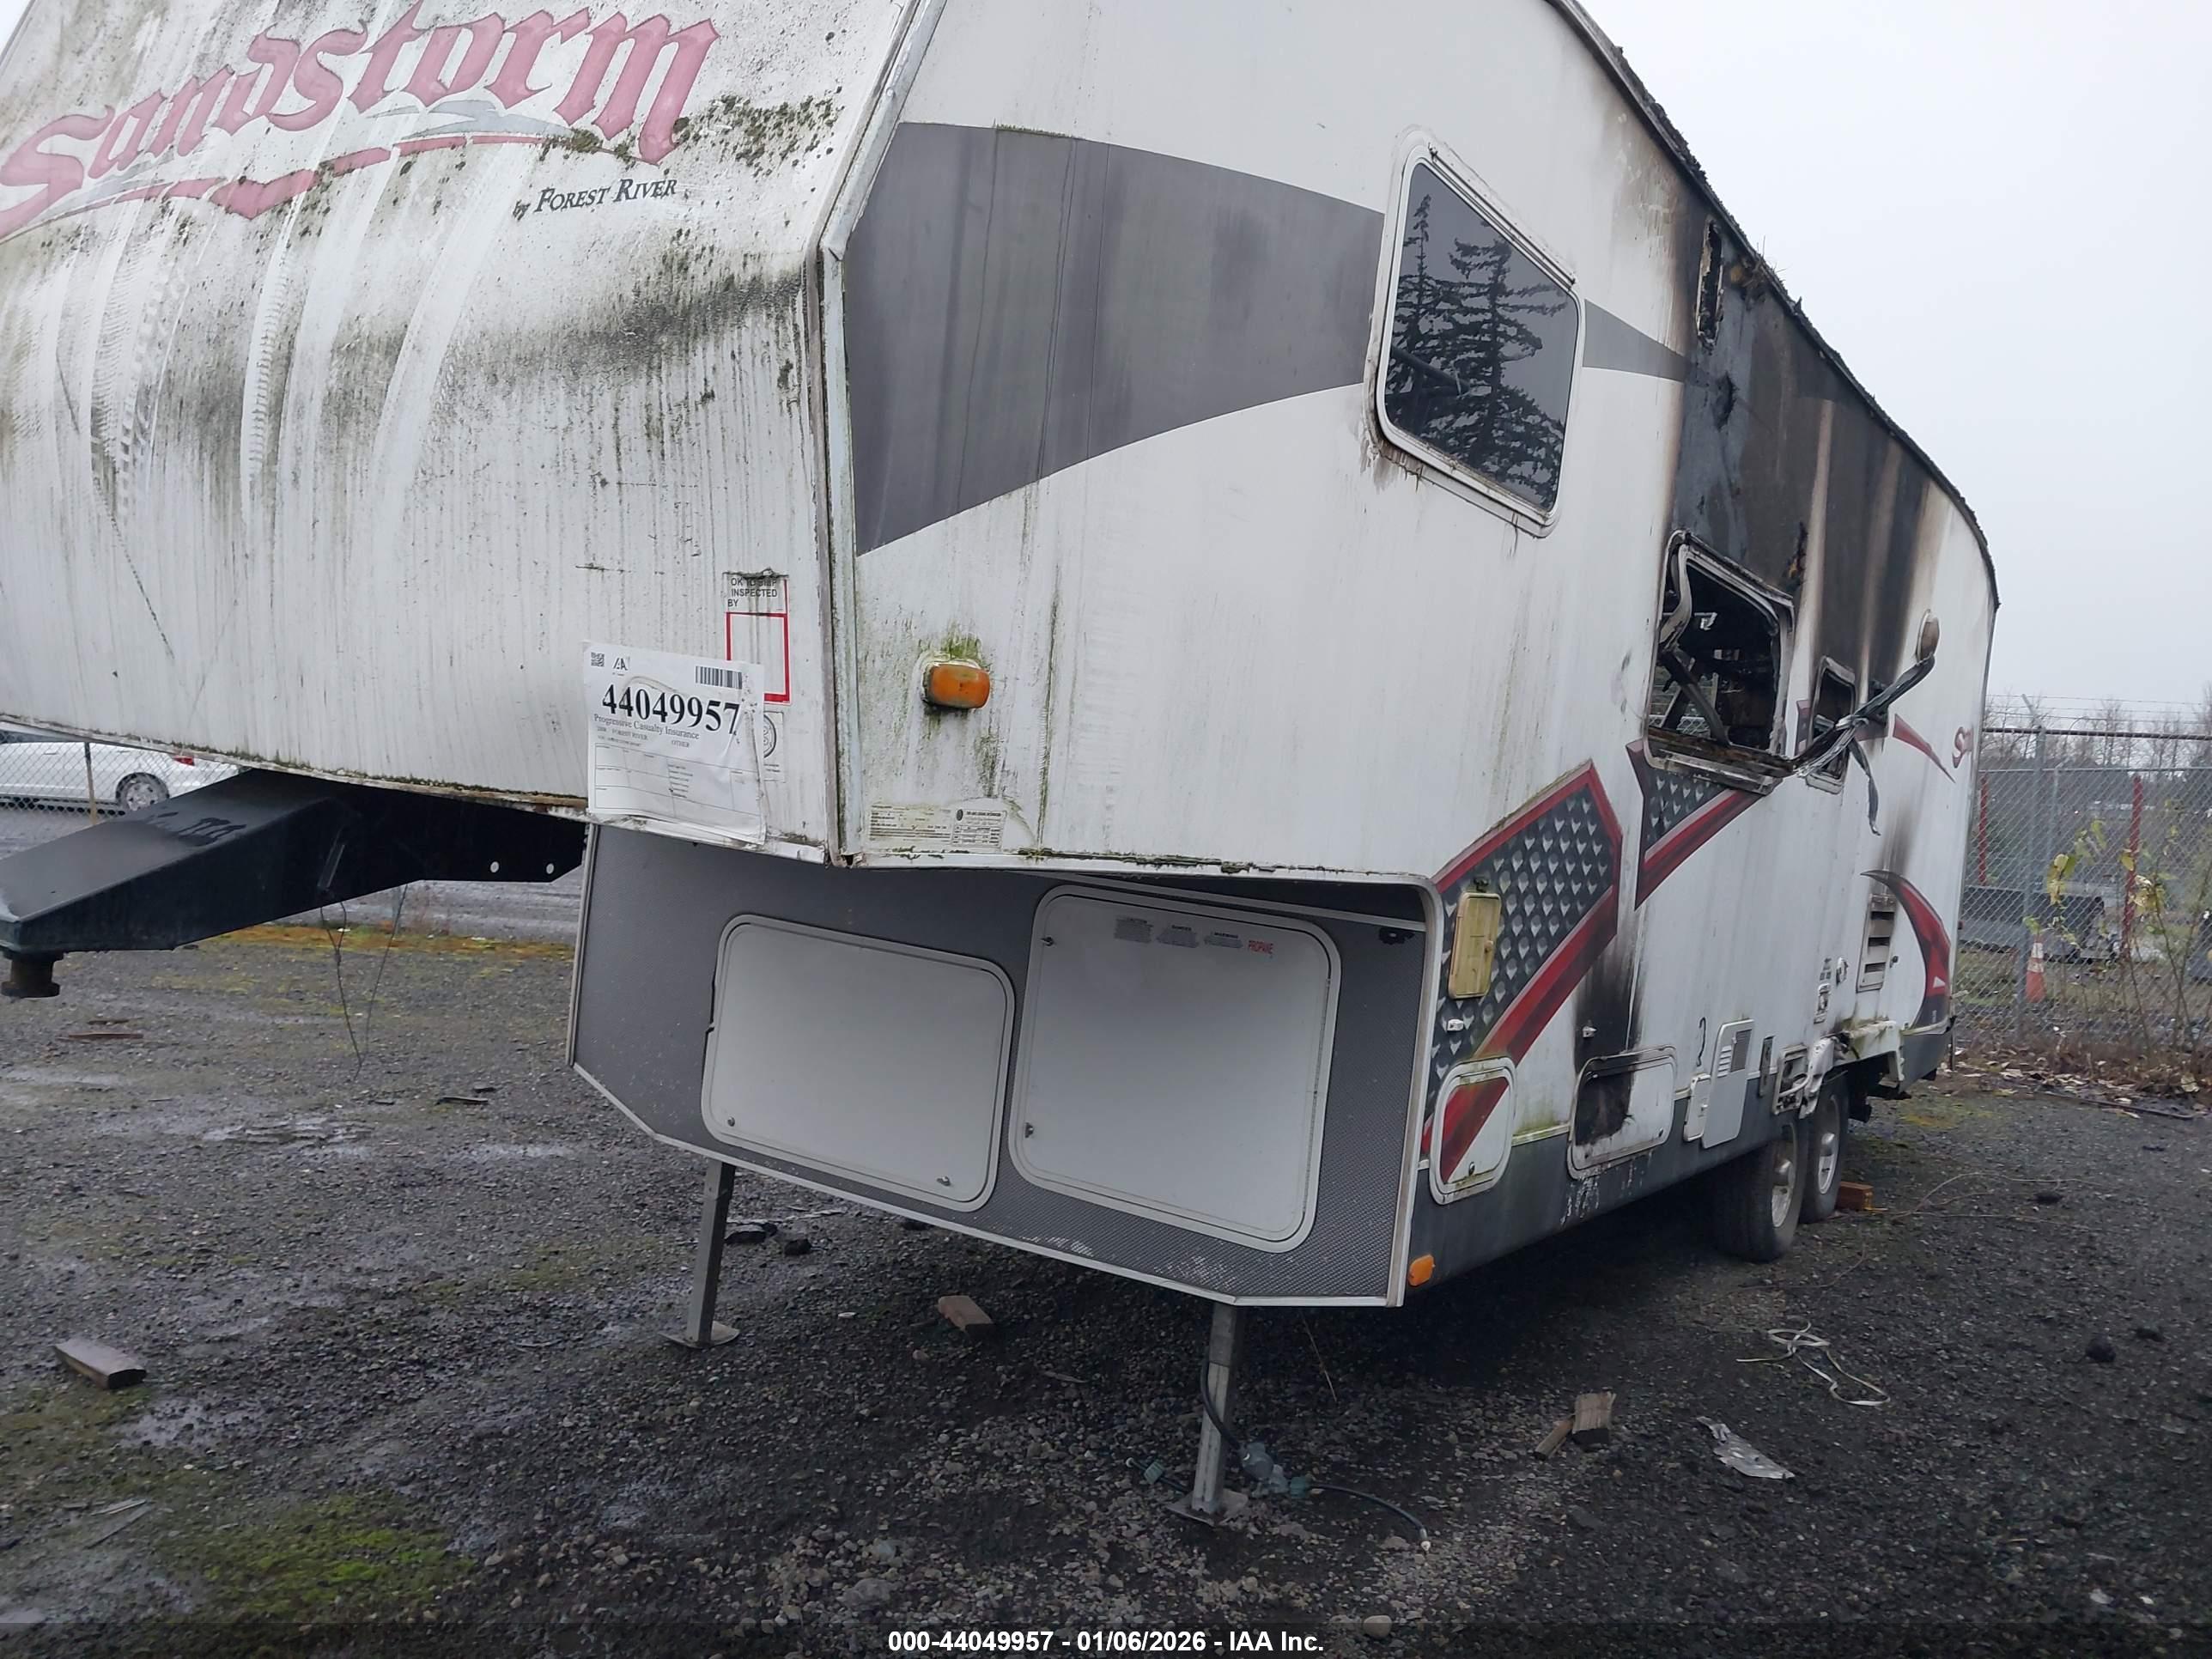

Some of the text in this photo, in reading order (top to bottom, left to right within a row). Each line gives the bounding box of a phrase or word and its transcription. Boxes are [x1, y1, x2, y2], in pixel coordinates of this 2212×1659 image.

[731, 588, 778, 598] INSPECTED
[727, 599, 739, 607] BY
[602, 684, 742, 736] 44049957
[665, 725, 700, 740] Insurance
